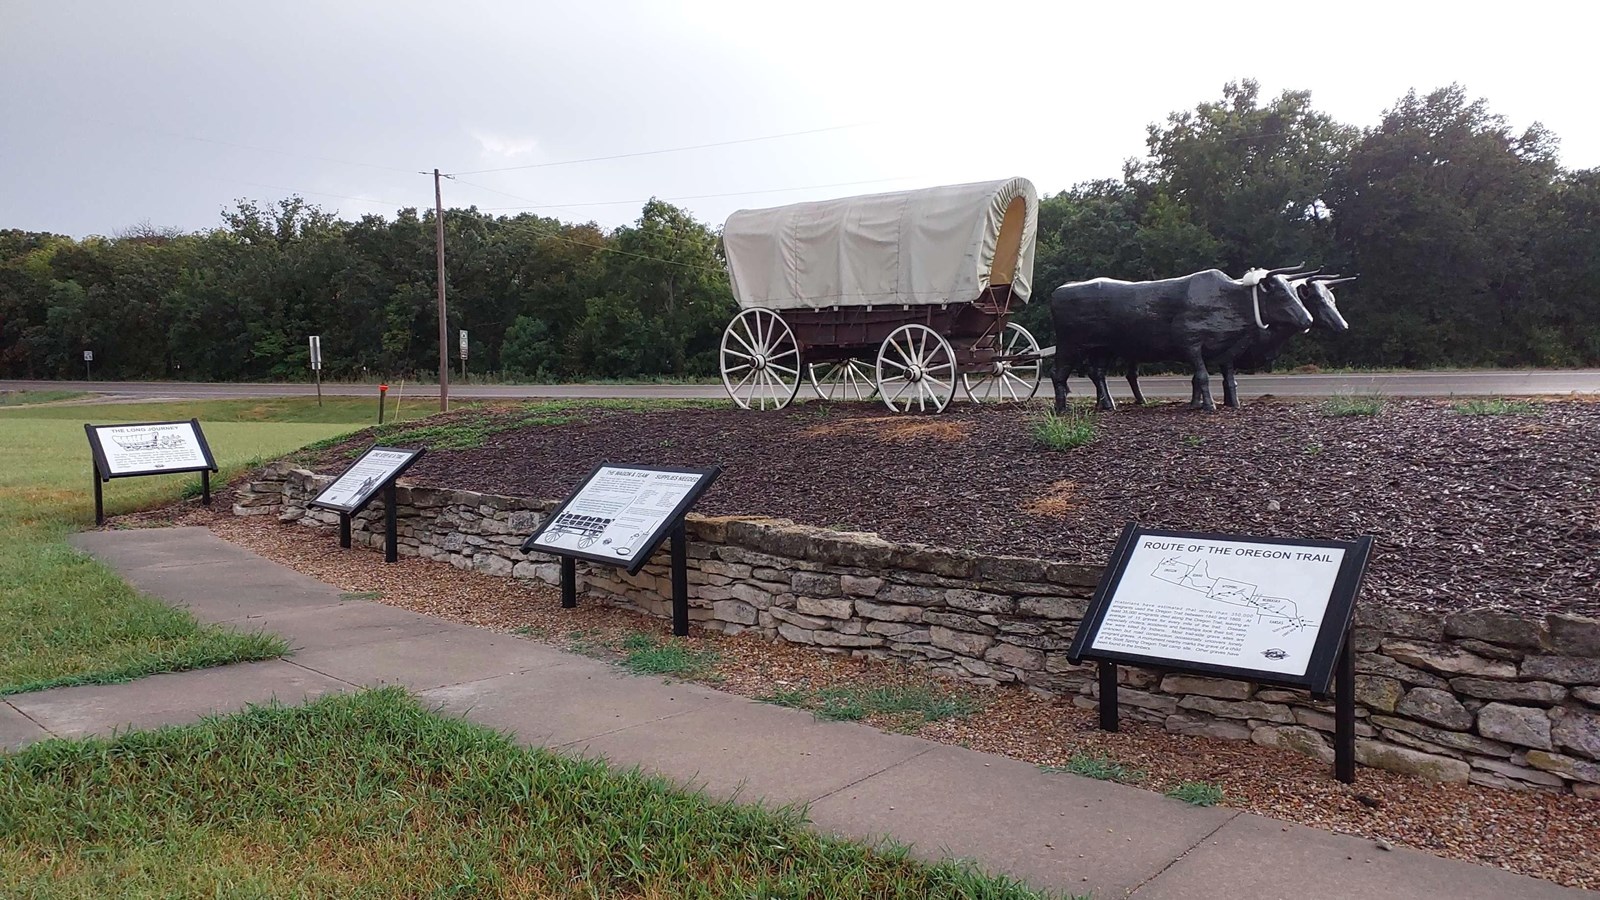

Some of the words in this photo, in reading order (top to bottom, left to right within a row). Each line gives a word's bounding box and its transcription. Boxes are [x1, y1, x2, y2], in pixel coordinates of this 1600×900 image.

[1143, 542, 1185, 551] ROUTE
[1207, 546, 1232, 555] THE
[1235, 548, 1291, 559] OREGON
[1294, 552, 1334, 562] TRAIL
